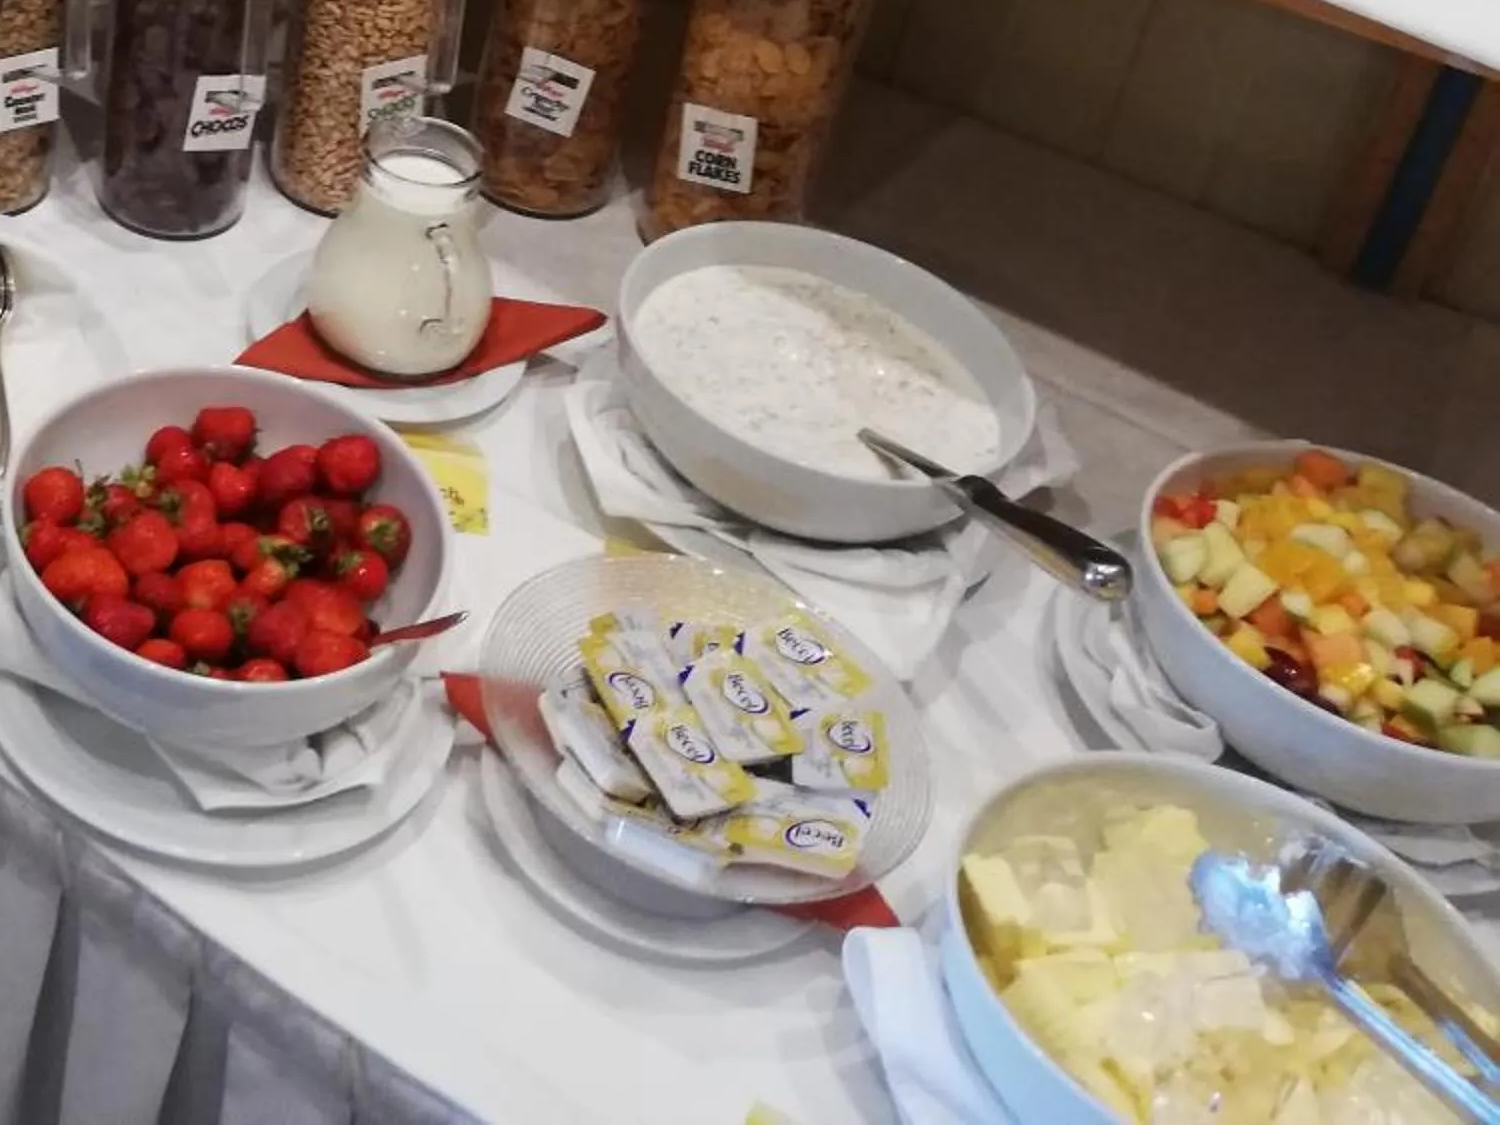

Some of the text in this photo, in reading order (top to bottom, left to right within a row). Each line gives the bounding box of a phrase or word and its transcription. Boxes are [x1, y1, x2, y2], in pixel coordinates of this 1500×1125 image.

[694, 150, 737, 169] CORN
[688, 161, 741, 184] FLAKES
[793, 825, 846, 849] Becel
